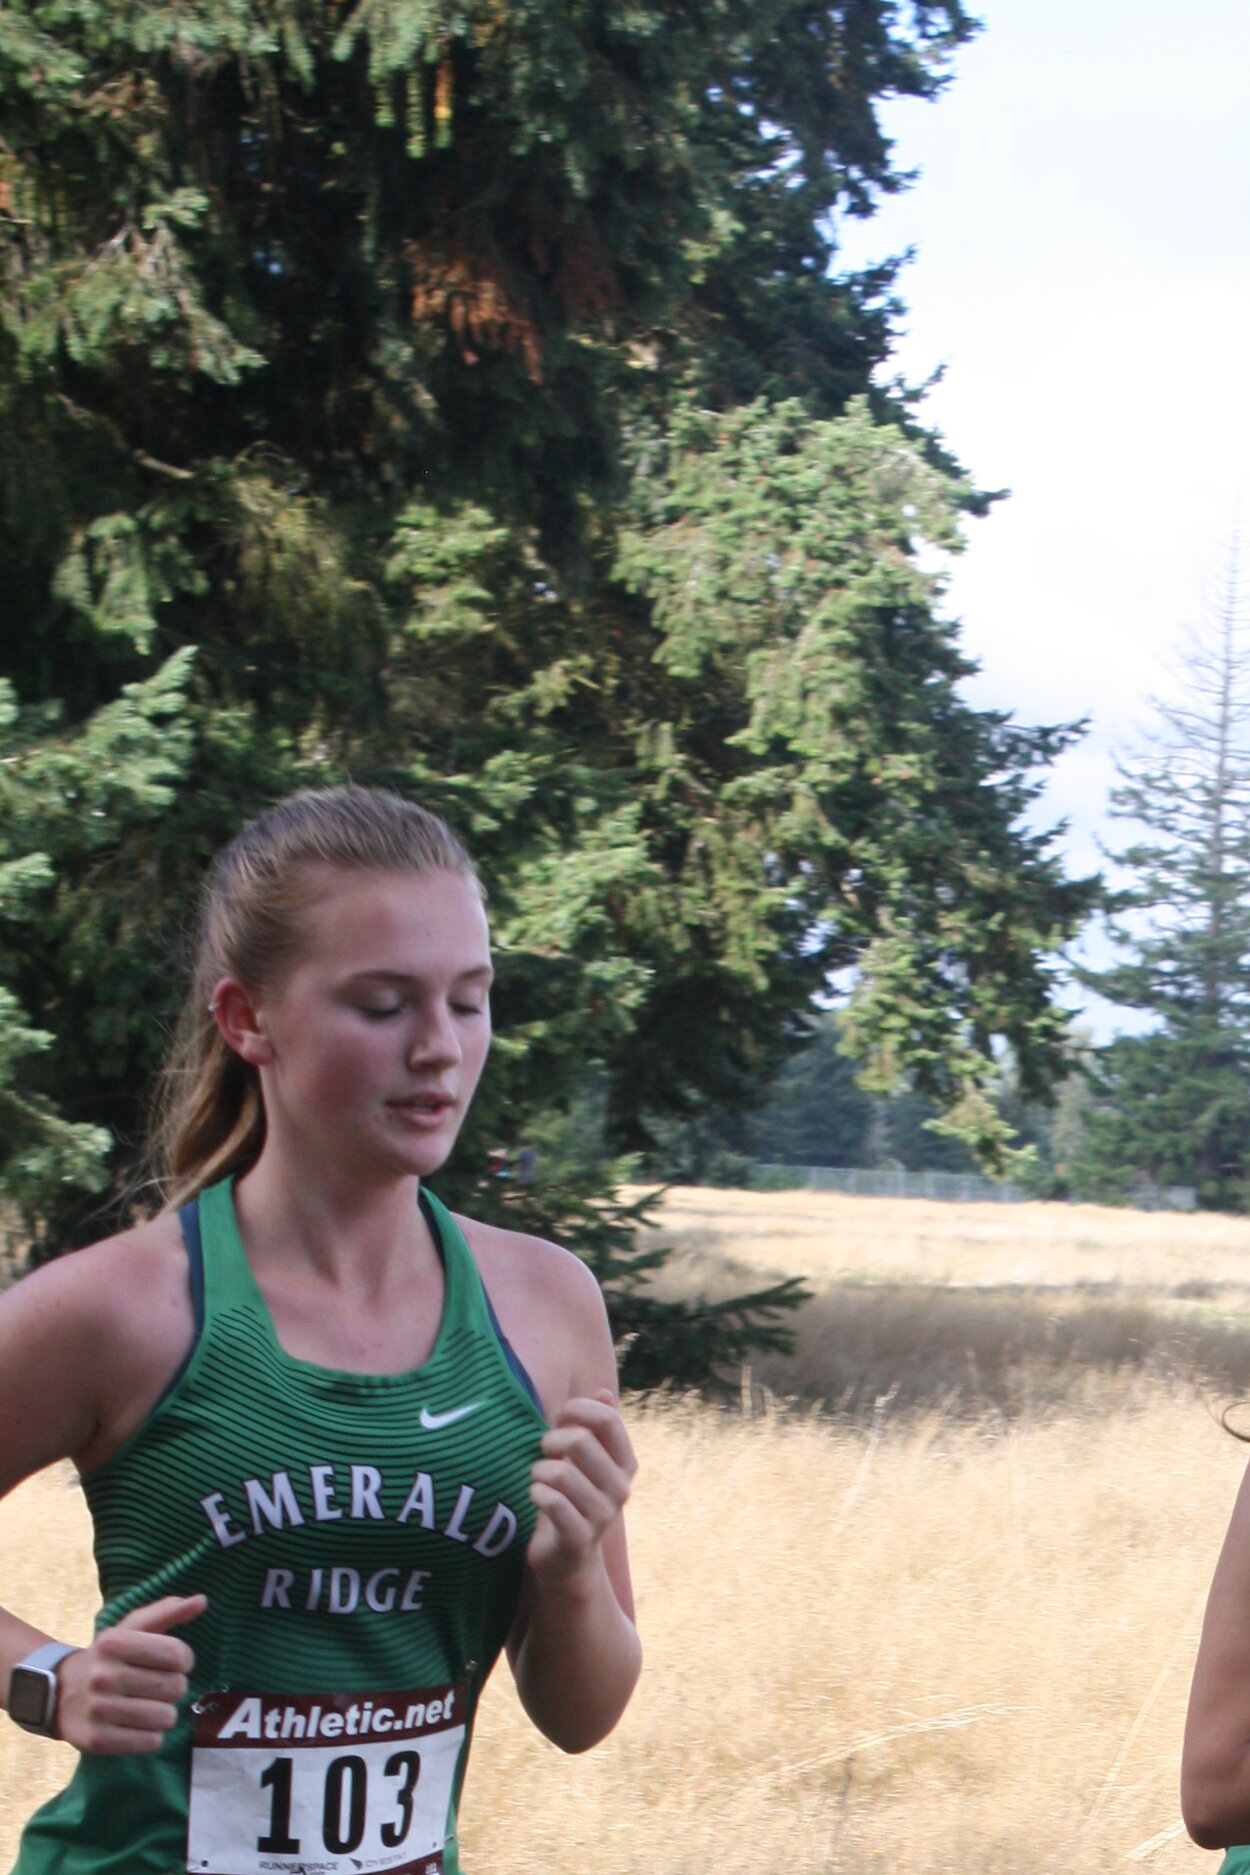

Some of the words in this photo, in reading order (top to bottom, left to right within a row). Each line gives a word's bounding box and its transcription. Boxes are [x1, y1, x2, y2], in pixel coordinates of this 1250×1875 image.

[201, 1465, 518, 1557] EMERALD
[260, 1566, 432, 1614] RIDGE
[217, 1694, 453, 1739] Athletic.net
[257, 1750, 421, 1854] 103
